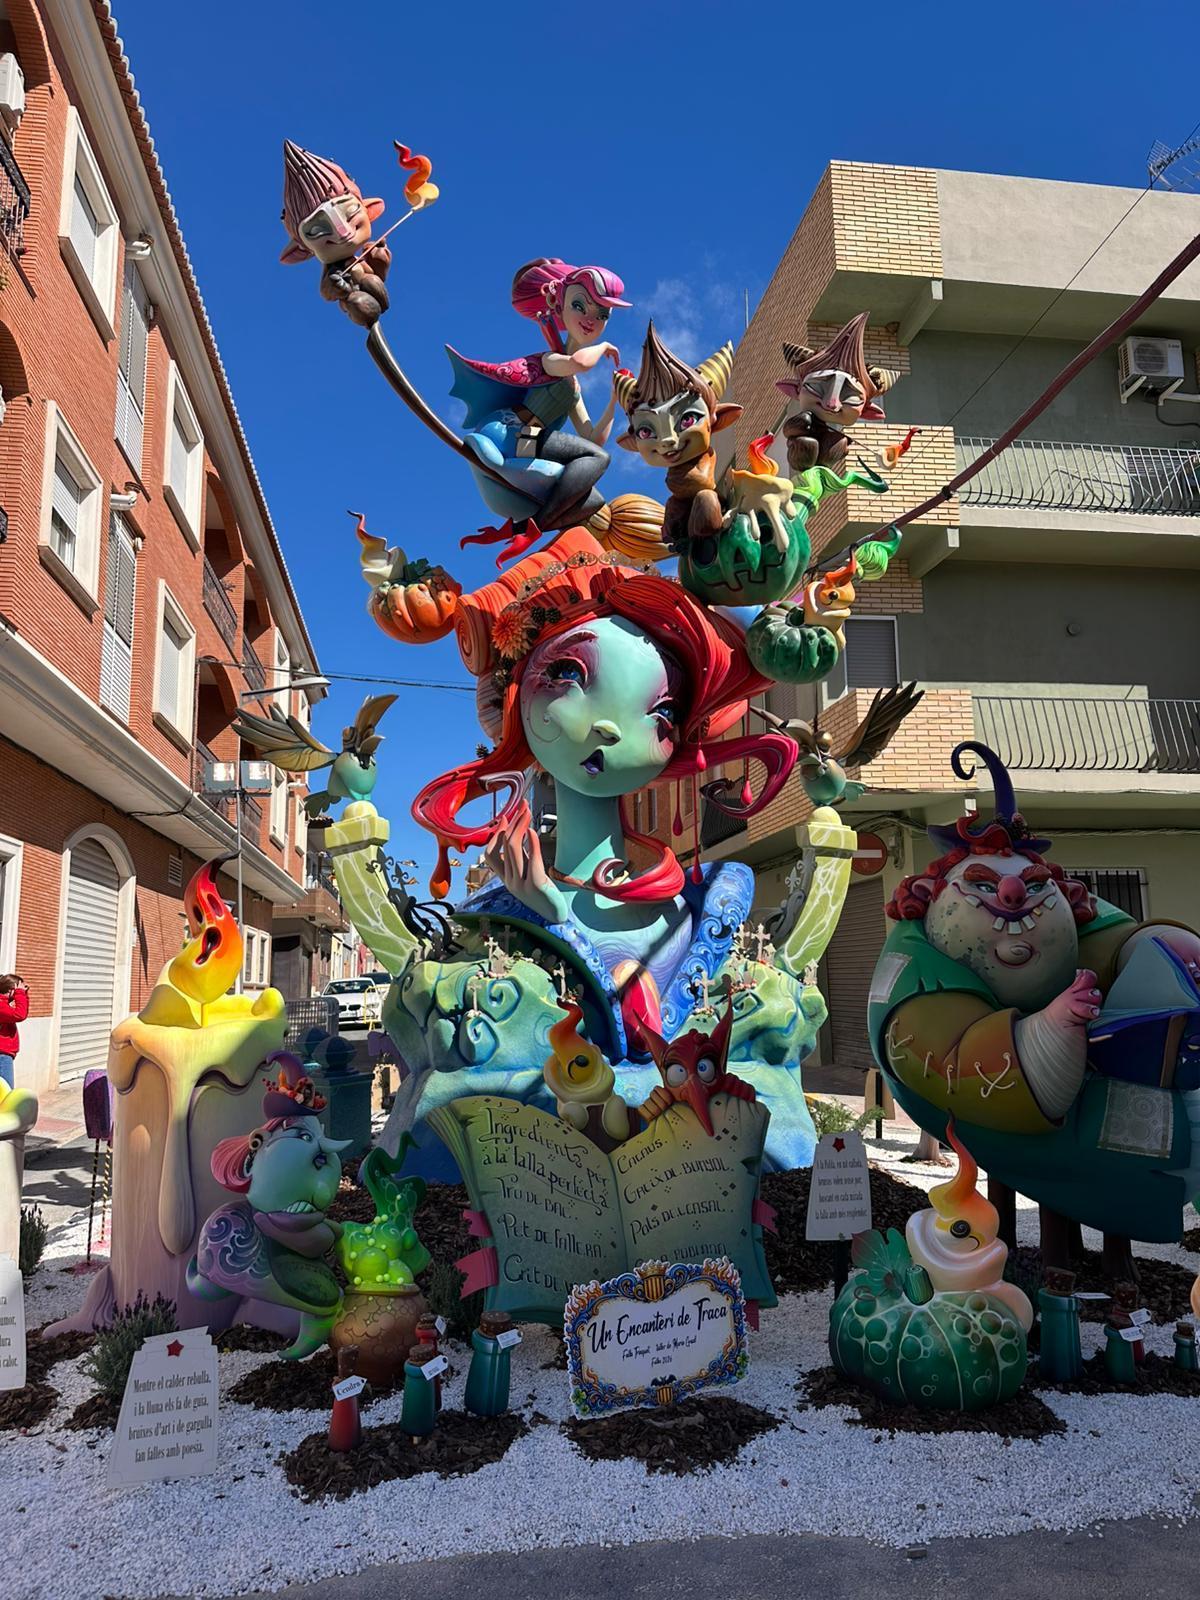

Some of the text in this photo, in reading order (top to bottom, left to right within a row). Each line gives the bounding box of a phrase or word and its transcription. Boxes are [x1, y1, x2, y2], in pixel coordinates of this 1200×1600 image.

[477, 1102, 588, 1168] Ingredients
[495, 1147, 507, 1164] la
[587, 1298, 728, 1353] Un Encanteri de Traca
[134, 1379, 157, 1393] Mentre
[158, 1376, 164, 1390] el
[165, 1374, 186, 1388] calder
[336, 1382, 361, 1396] Cendra
[138, 1402, 145, 1415] la
[146, 1400, 163, 1414] lluna
[164, 1398, 174, 1412] els
[176, 1398, 182, 1410] fa
[183, 1396, 192, 1409] de
[128, 1424, 153, 1440] bruixes
[176, 1419, 185, 1433] de
[135, 1448, 146, 1463] fan
[147, 1446, 165, 1461] falles
[166, 1443, 180, 1458] amb
